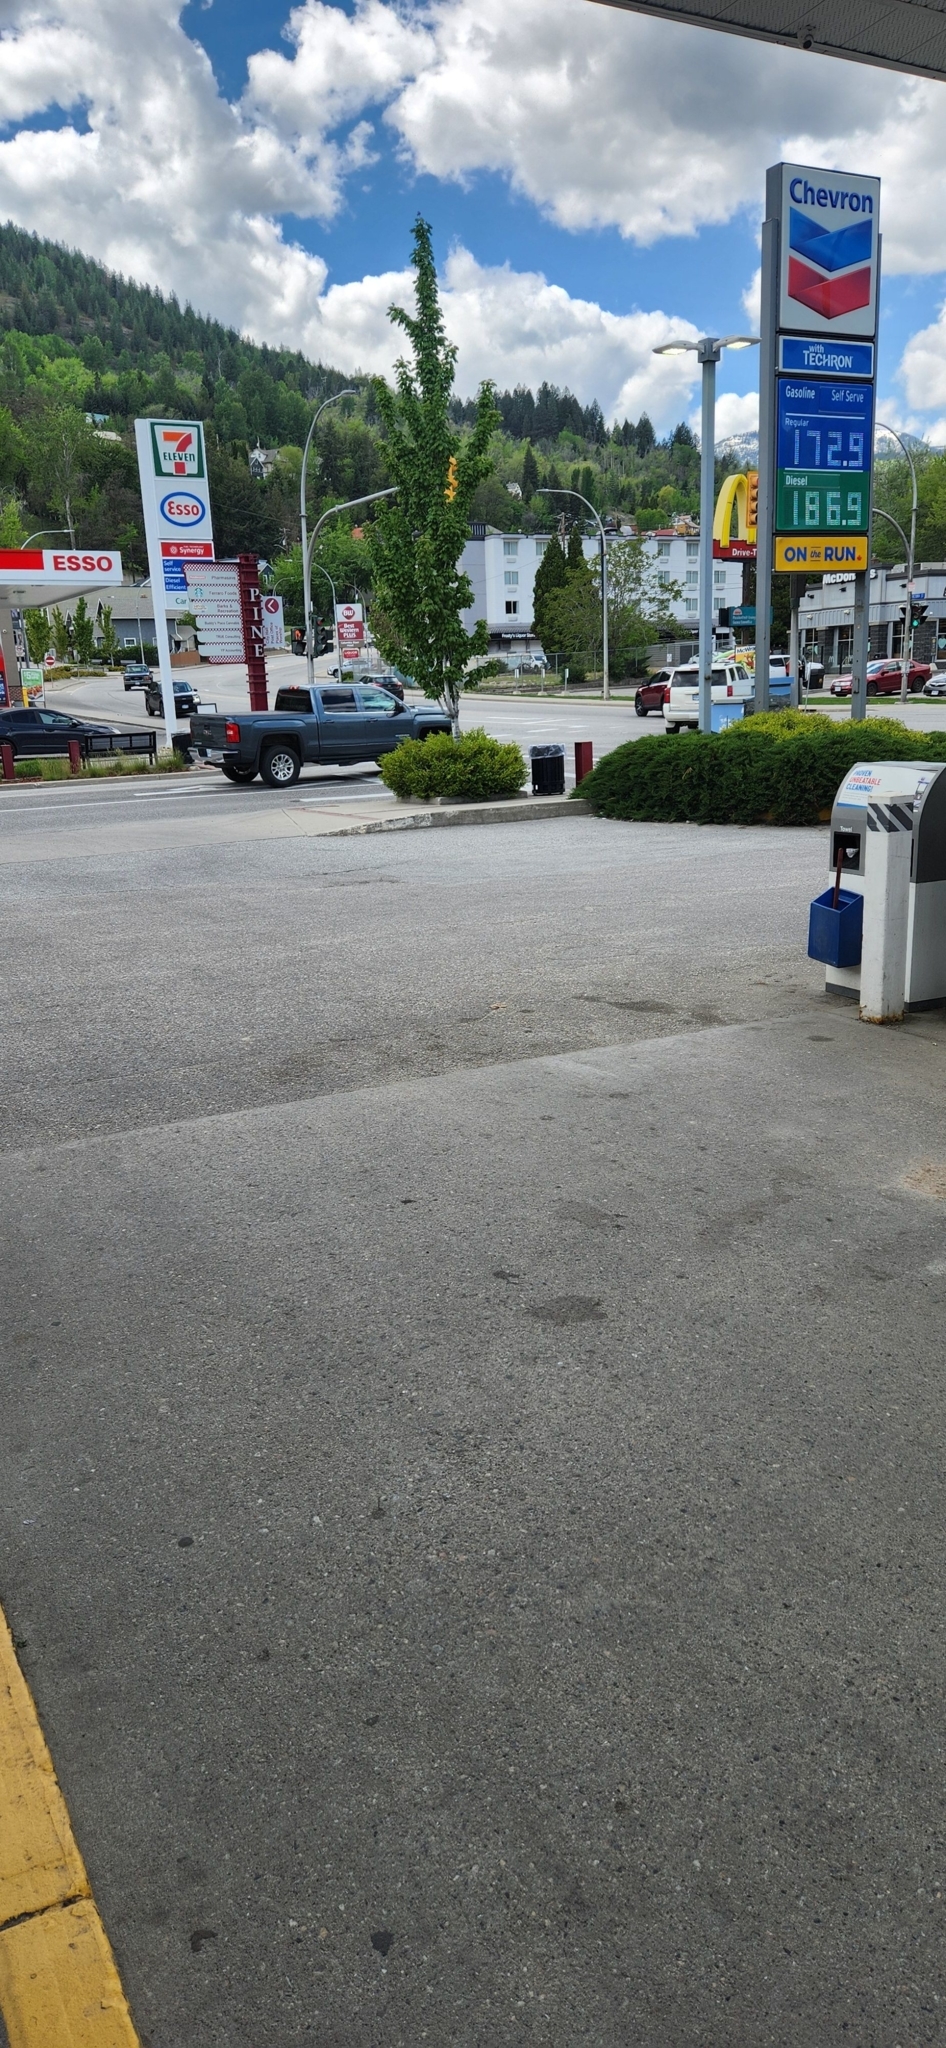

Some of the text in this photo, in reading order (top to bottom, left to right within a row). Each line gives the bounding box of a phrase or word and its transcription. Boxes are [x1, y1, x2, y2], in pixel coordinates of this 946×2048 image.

[789, 177, 873, 214] Chevron
[809, 343, 824, 354] with
[803, 350, 852, 370] TECHRON
[785, 385, 864, 403] Gasoline Self Serve
[785, 418, 809, 427] Regular
[163, 431, 192, 475] 7
[794, 429, 864, 467] 172.9
[785, 475, 808, 486] Diesel
[167, 500, 200, 516] Esso
[793, 490, 862, 526] 186.9
[179, 546, 204, 555] Synergy
[732, 548, 757, 556] Drive-T
[784, 546, 856, 562] ON the RUN
[53, 555, 113, 572] ESSO
[249, 588, 264, 657] PINE
[846, 784, 873, 792] CLEANING!
[849, 777, 881, 785] UNBEATABLE
